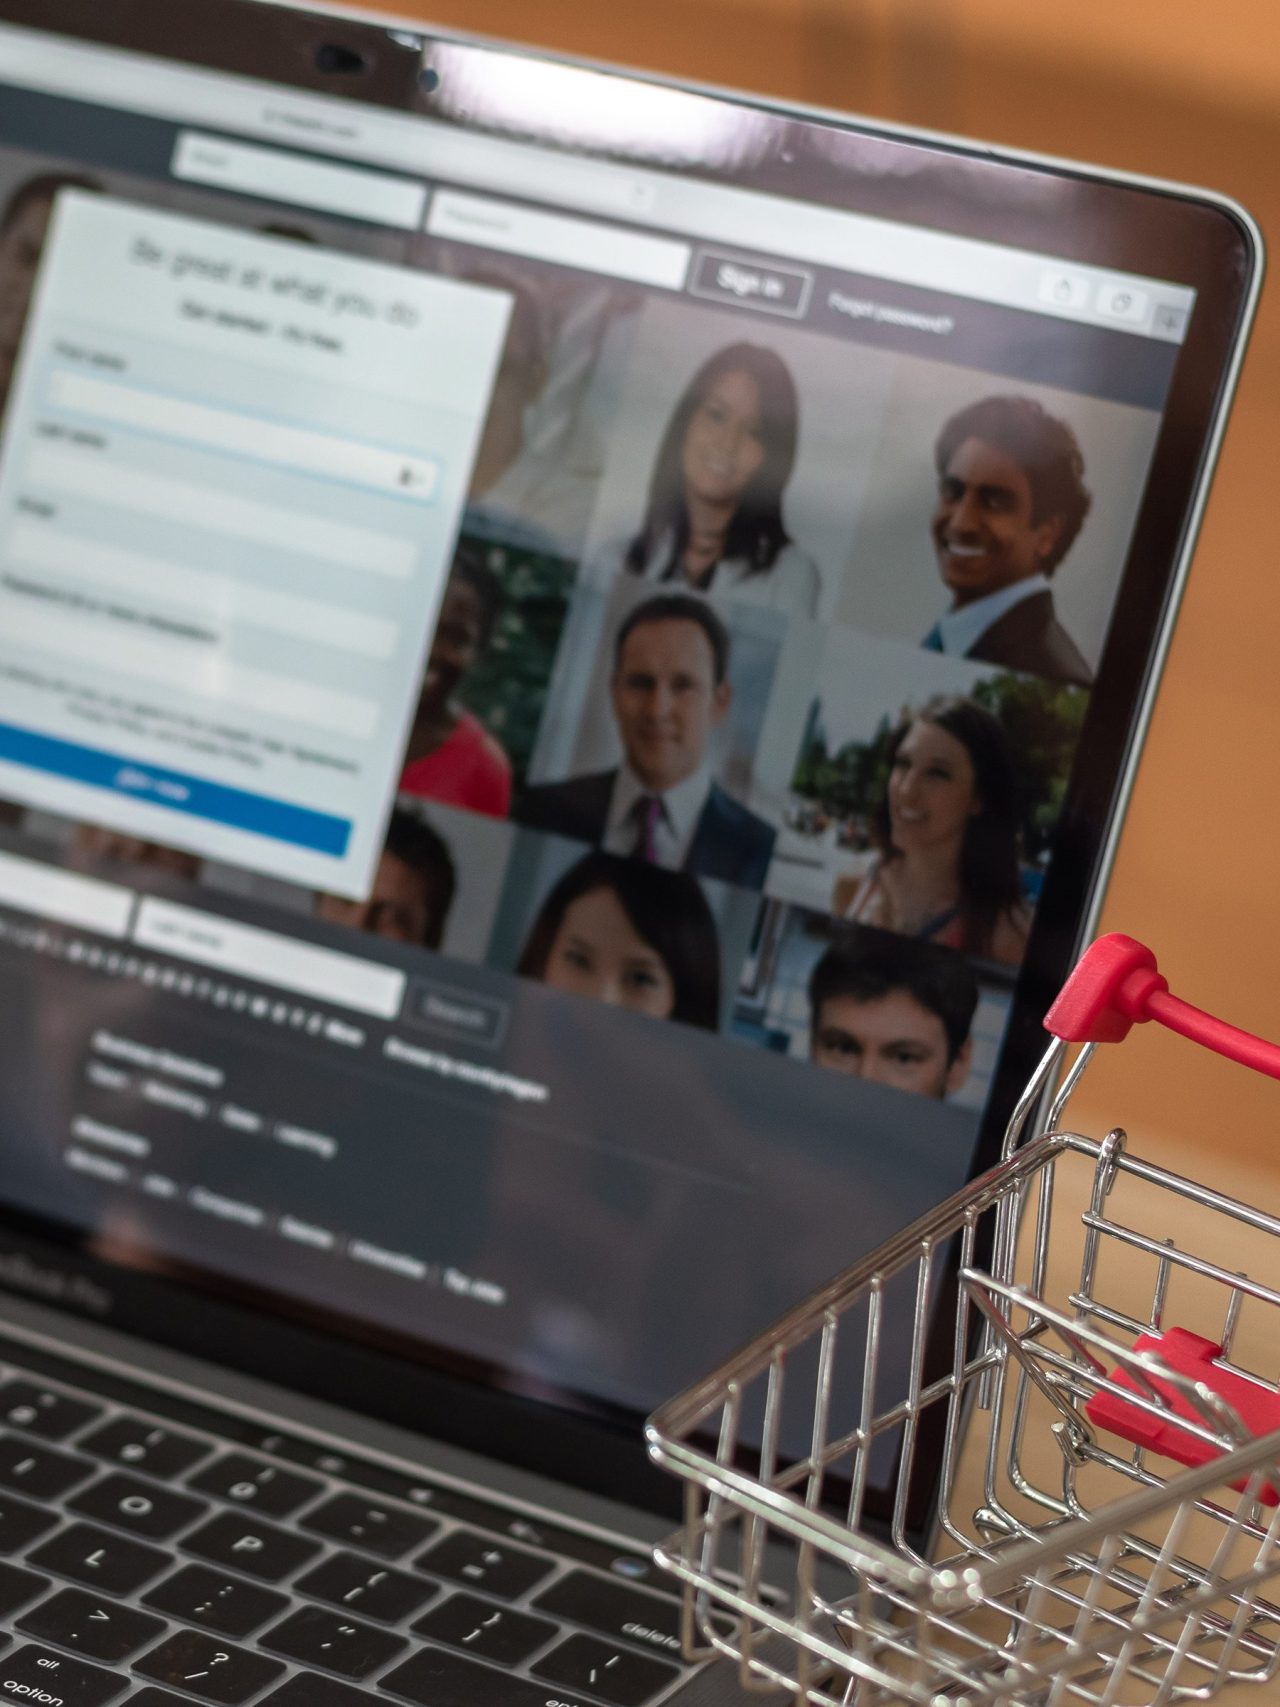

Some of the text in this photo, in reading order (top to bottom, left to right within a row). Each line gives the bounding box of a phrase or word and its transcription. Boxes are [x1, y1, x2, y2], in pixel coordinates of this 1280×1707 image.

[172, 253, 231, 285] great
[271, 272, 327, 306] what
[717, 264, 761, 298] Sign
[119, 1496, 154, 1517] O
[232, 1535, 265, 1553] P
[84, 1548, 107, 1568] L
[621, 1622, 681, 1650] delete
[36, 1658, 61, 1670] alt
[209, 1652, 230, 1666] ?
[2, 1679, 65, 1707] option
